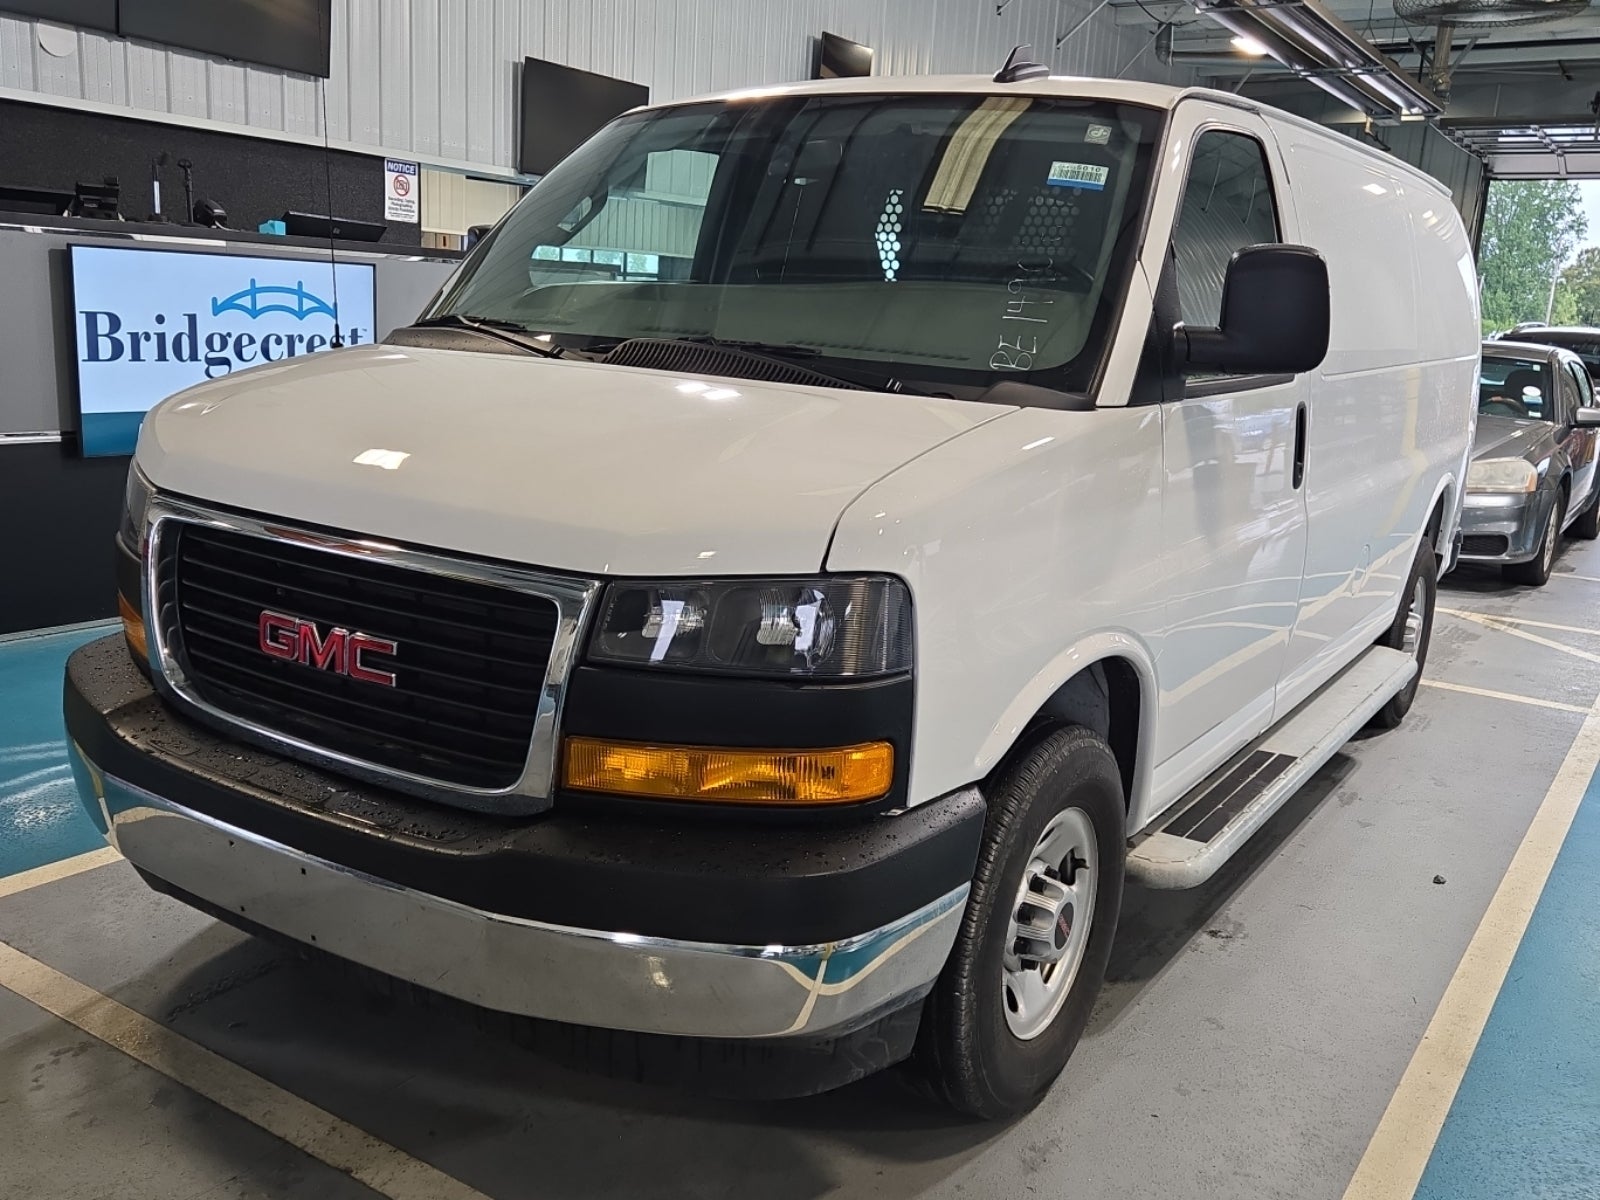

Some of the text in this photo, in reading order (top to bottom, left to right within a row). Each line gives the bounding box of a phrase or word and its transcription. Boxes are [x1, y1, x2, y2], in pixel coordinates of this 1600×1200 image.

[387, 162, 415, 174] NOTICE
[990, 335, 1037, 370] BE
[259, 610, 398, 687] GMC
